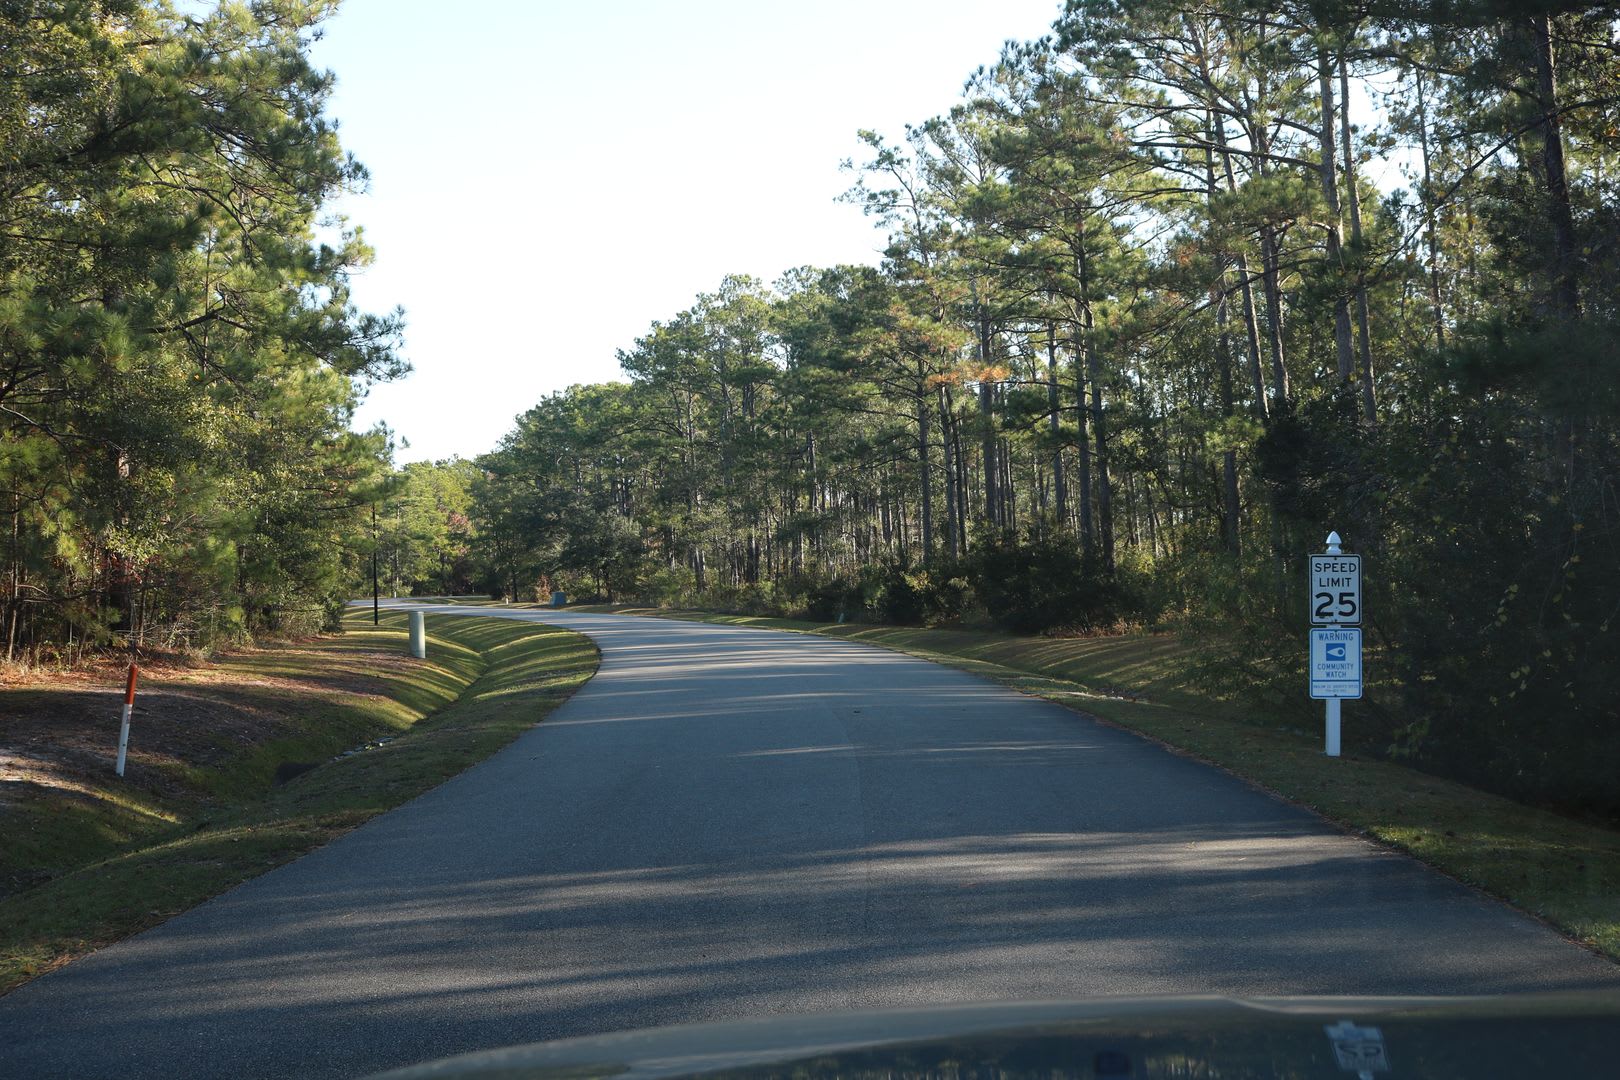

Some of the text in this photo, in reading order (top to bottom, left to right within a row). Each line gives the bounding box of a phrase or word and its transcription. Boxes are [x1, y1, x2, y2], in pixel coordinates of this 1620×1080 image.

[1314, 562, 1357, 572] SPEED
[1319, 577, 1352, 587] LIMIT
[1315, 592, 1357, 617] 25
[1318, 632, 1354, 641] WARNING
